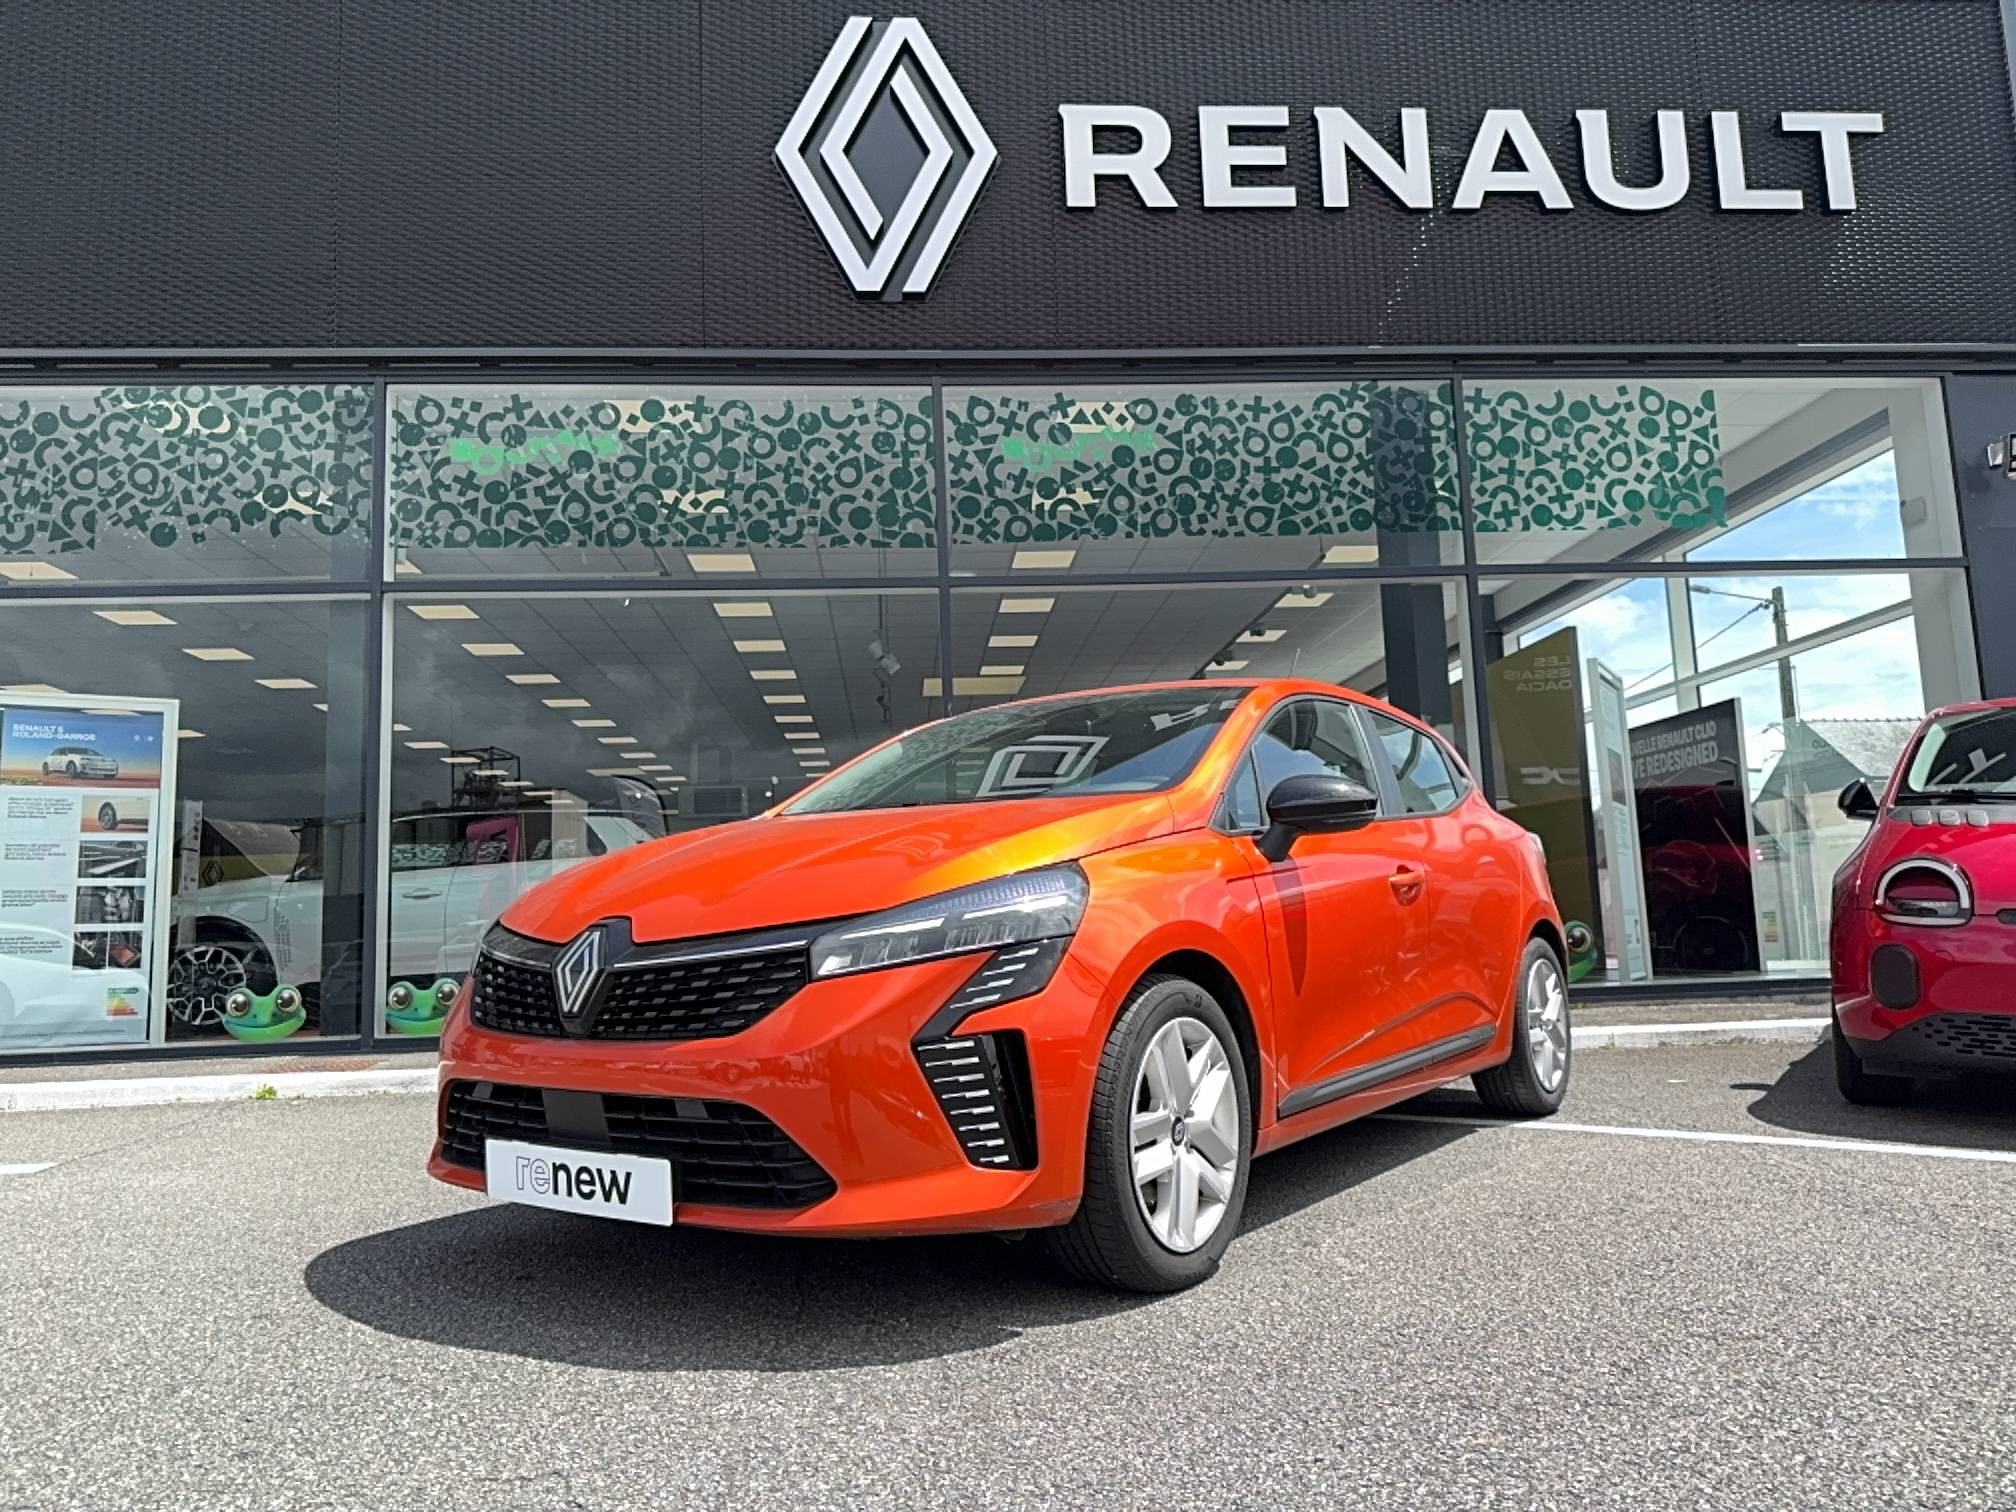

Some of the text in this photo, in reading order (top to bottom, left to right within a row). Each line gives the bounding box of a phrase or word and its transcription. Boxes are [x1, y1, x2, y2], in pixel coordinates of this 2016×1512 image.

[1058, 103, 1885, 212] RENAULT
[1631, 720, 1717, 757] VELLE RENAULT CLIO
[1646, 740, 1719, 776] REDESIGNED
[515, 1155, 632, 1205] renew
